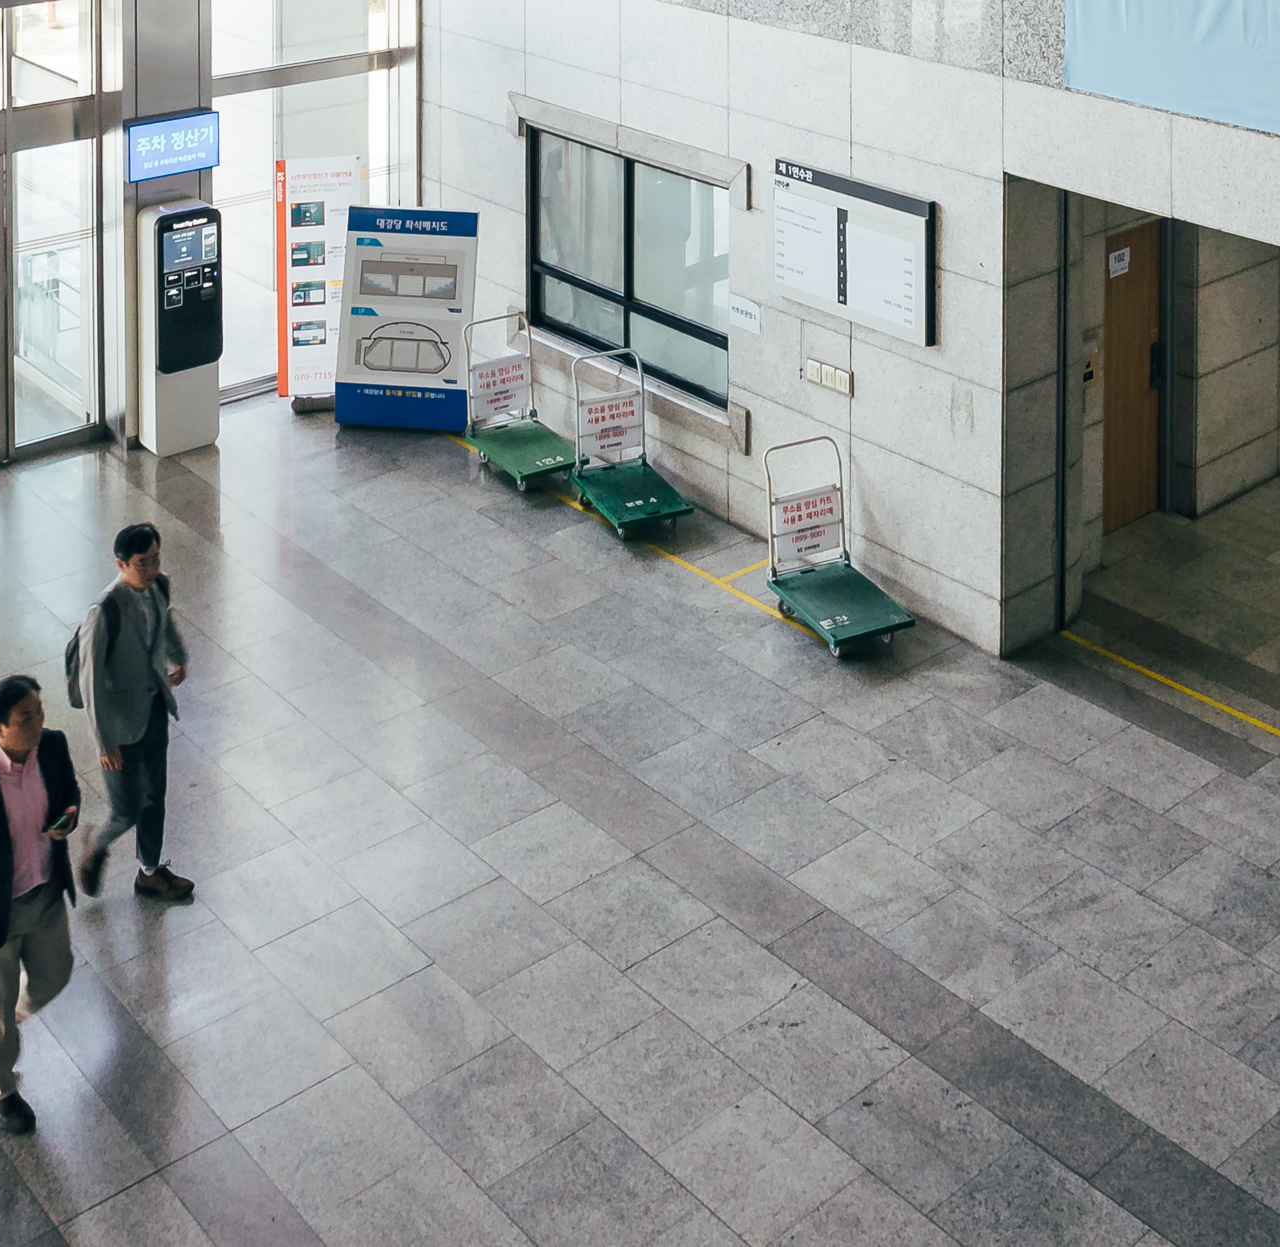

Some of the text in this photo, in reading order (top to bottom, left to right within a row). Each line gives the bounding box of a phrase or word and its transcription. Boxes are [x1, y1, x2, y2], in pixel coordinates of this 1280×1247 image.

[136, 125, 214, 157] 주차 정산기
[779, 163, 787, 175] 제
[376, 218, 448, 232] 대강당 좌석배치도
[1114, 252, 1125, 264] 102
[622, 400, 634, 408] 카트
[804, 499, 818, 510] 양심
[819, 495, 833, 506] 카트
[791, 530, 826, 543] 1899-9001
